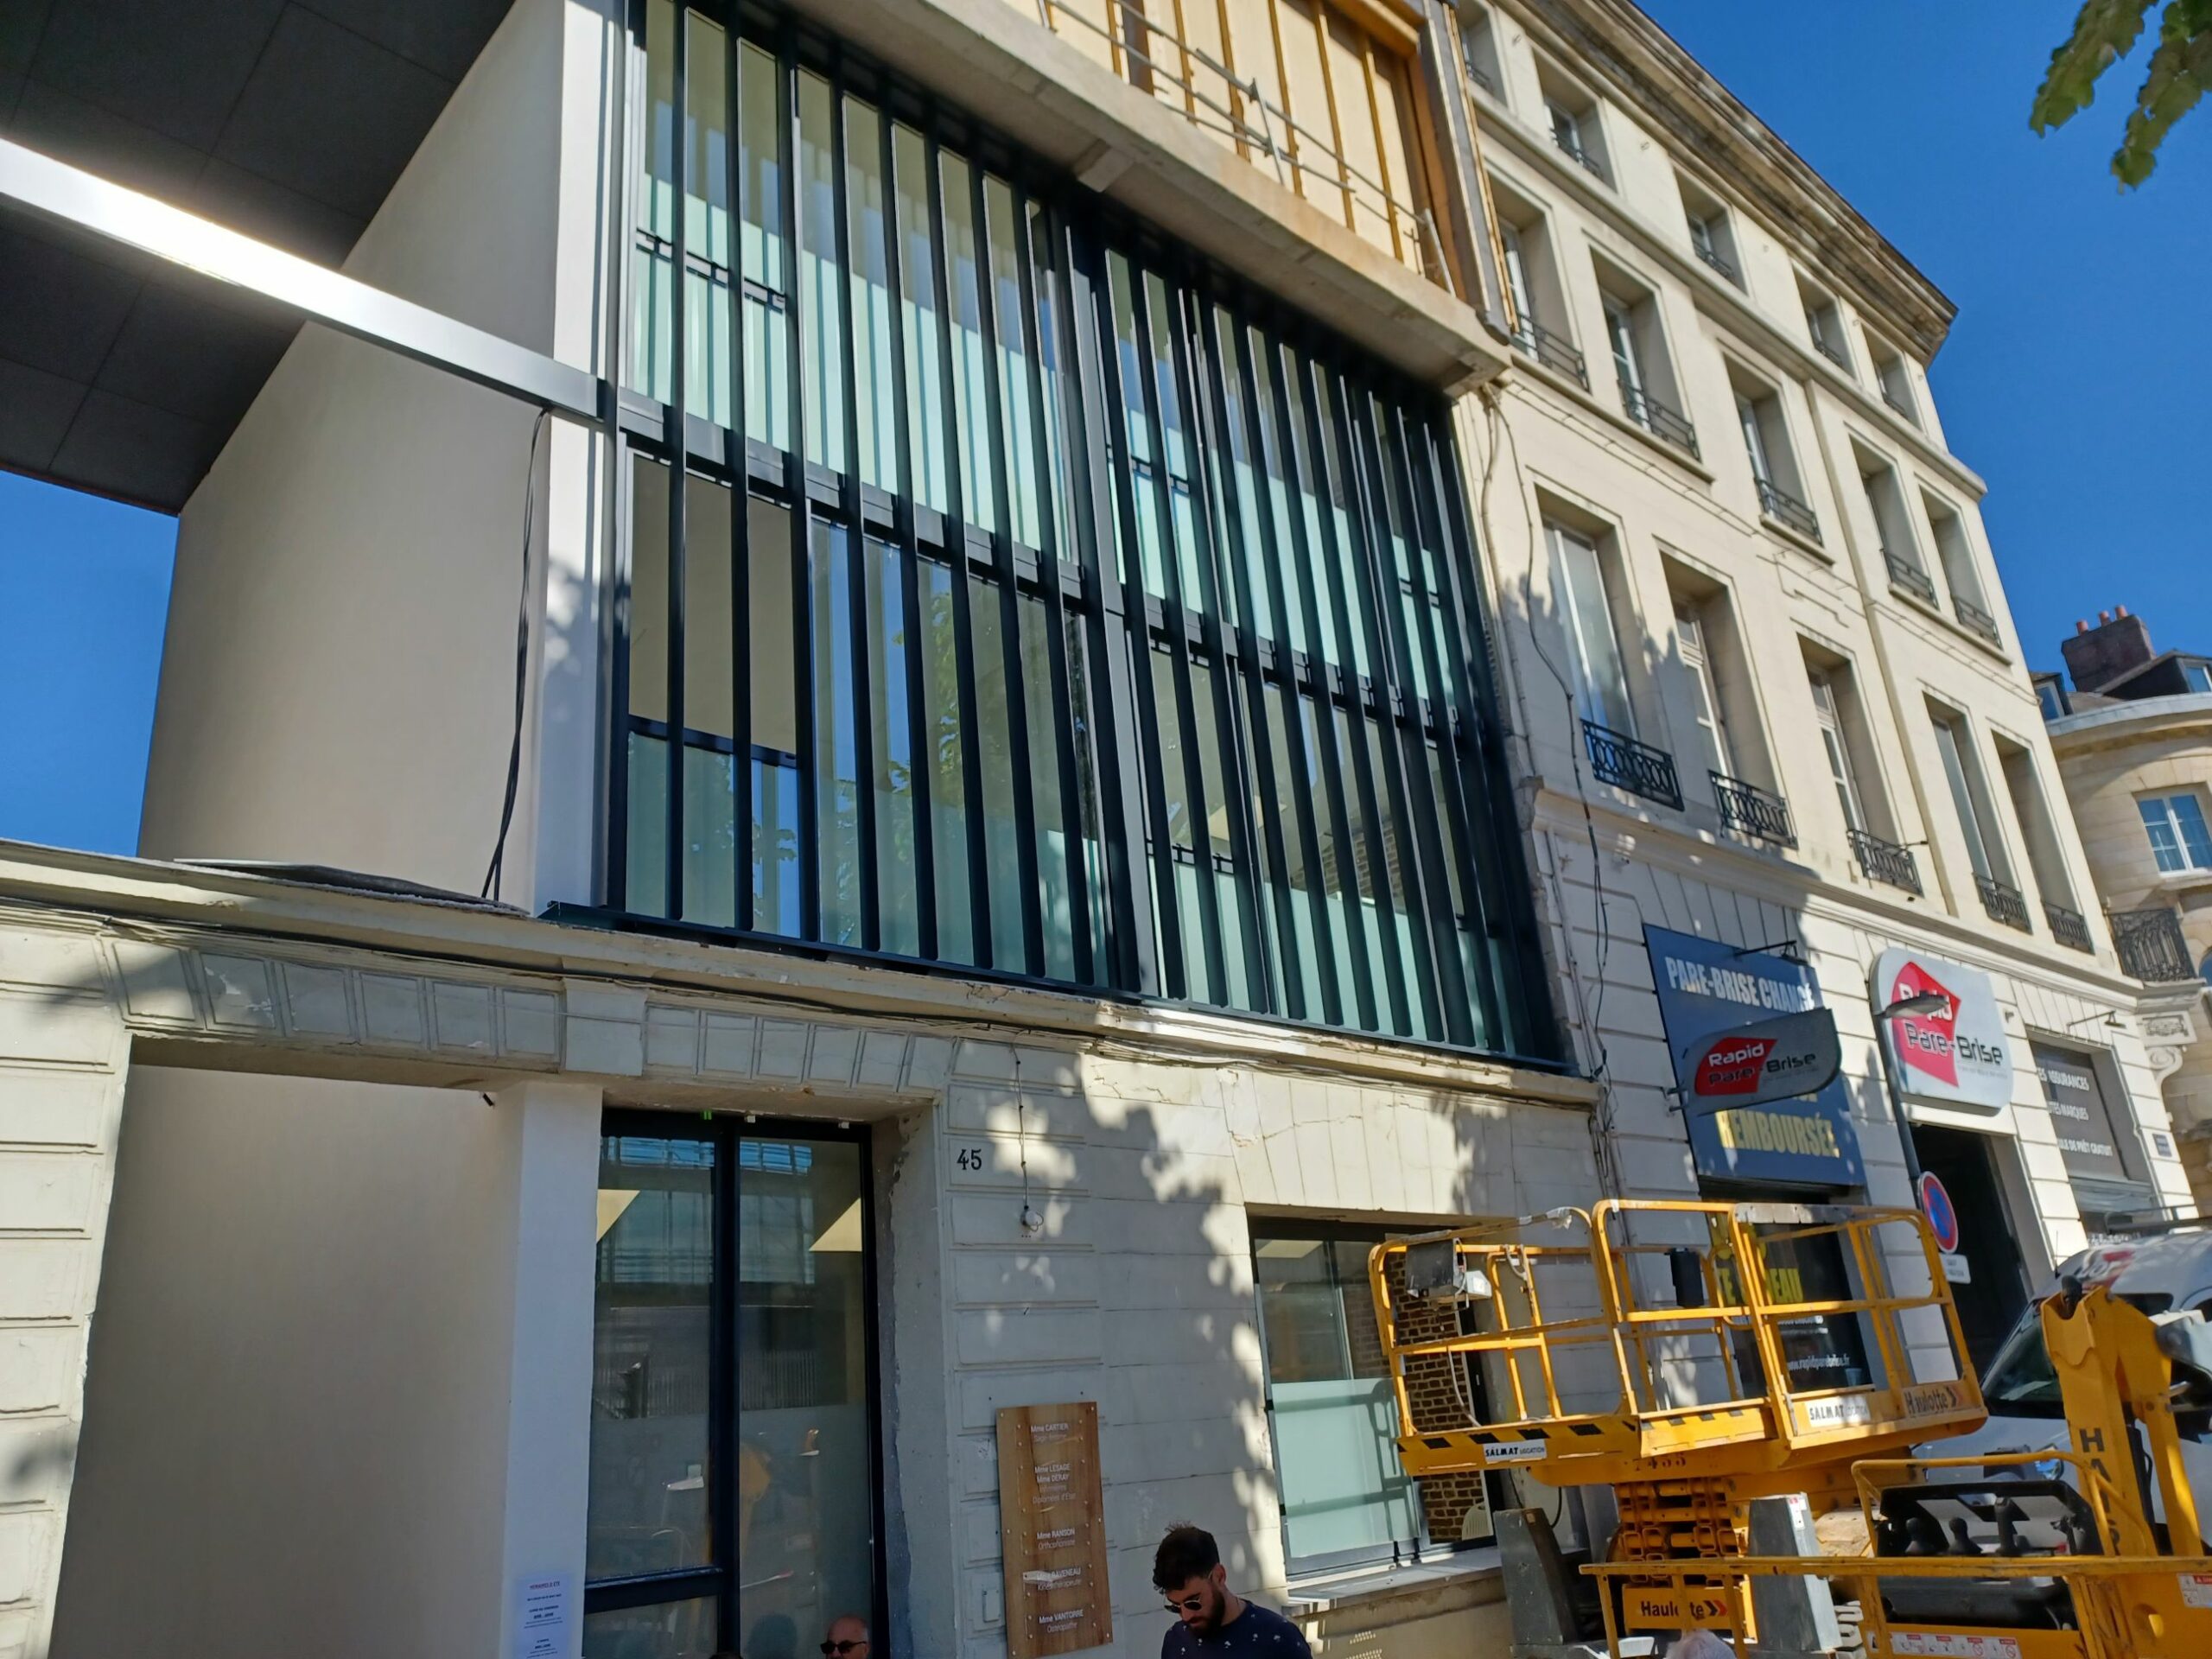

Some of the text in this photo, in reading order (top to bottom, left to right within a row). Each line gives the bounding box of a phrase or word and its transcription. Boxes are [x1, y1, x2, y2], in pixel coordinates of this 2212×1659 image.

[1665, 957, 1759, 1007] PARE-BRISE
[1708, 1043, 1765, 1067] Rapid
[1714, 1109, 1840, 1158] REMBOURSÉE
[957, 1148, 982, 1170] 45
[1808, 1405, 1845, 1421] SALMAT
[1485, 1446, 1518, 1458] SALMAT
[1640, 1600, 1705, 1618] Haulte
